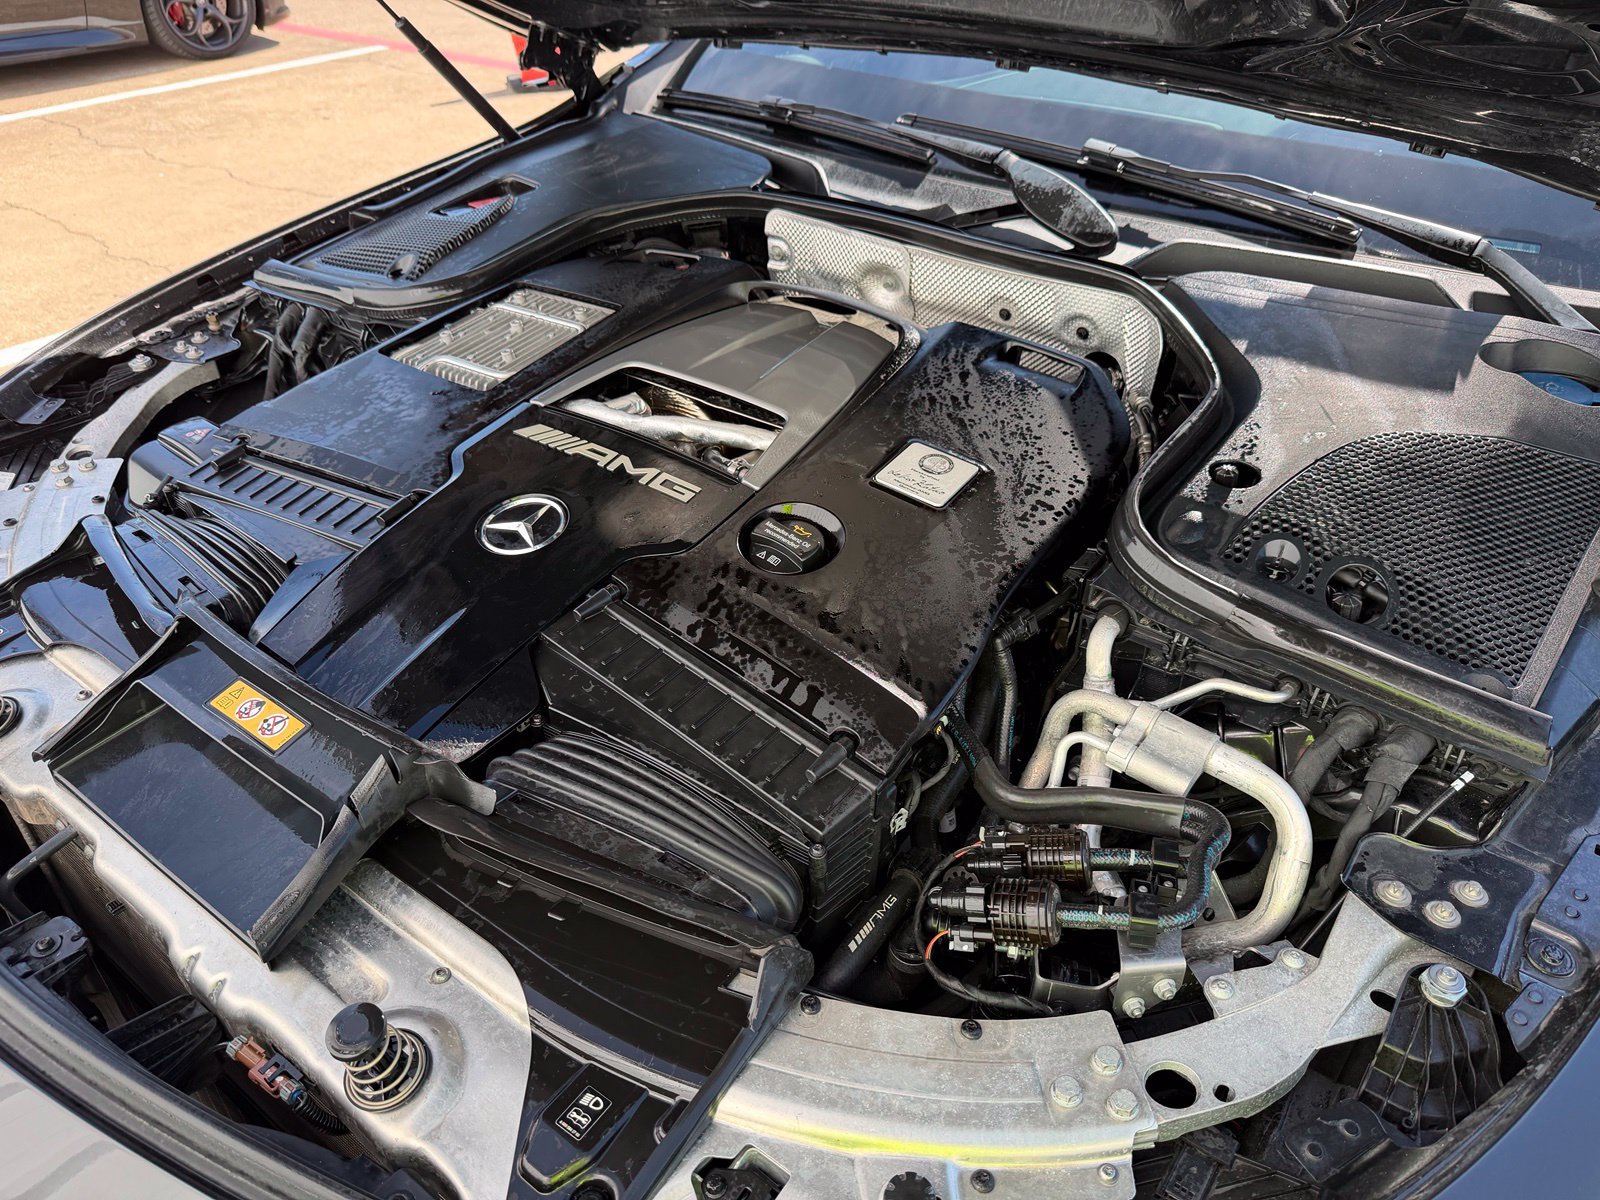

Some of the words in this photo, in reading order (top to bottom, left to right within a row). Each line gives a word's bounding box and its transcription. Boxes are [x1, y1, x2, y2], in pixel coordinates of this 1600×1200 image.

[564, 442, 702, 503] AMG
[764, 528, 799, 549] recommended
[765, 521, 802, 544] Mercedes-Benz
[801, 540, 811, 549] Oil
[869, 894, 898, 928] AMG
